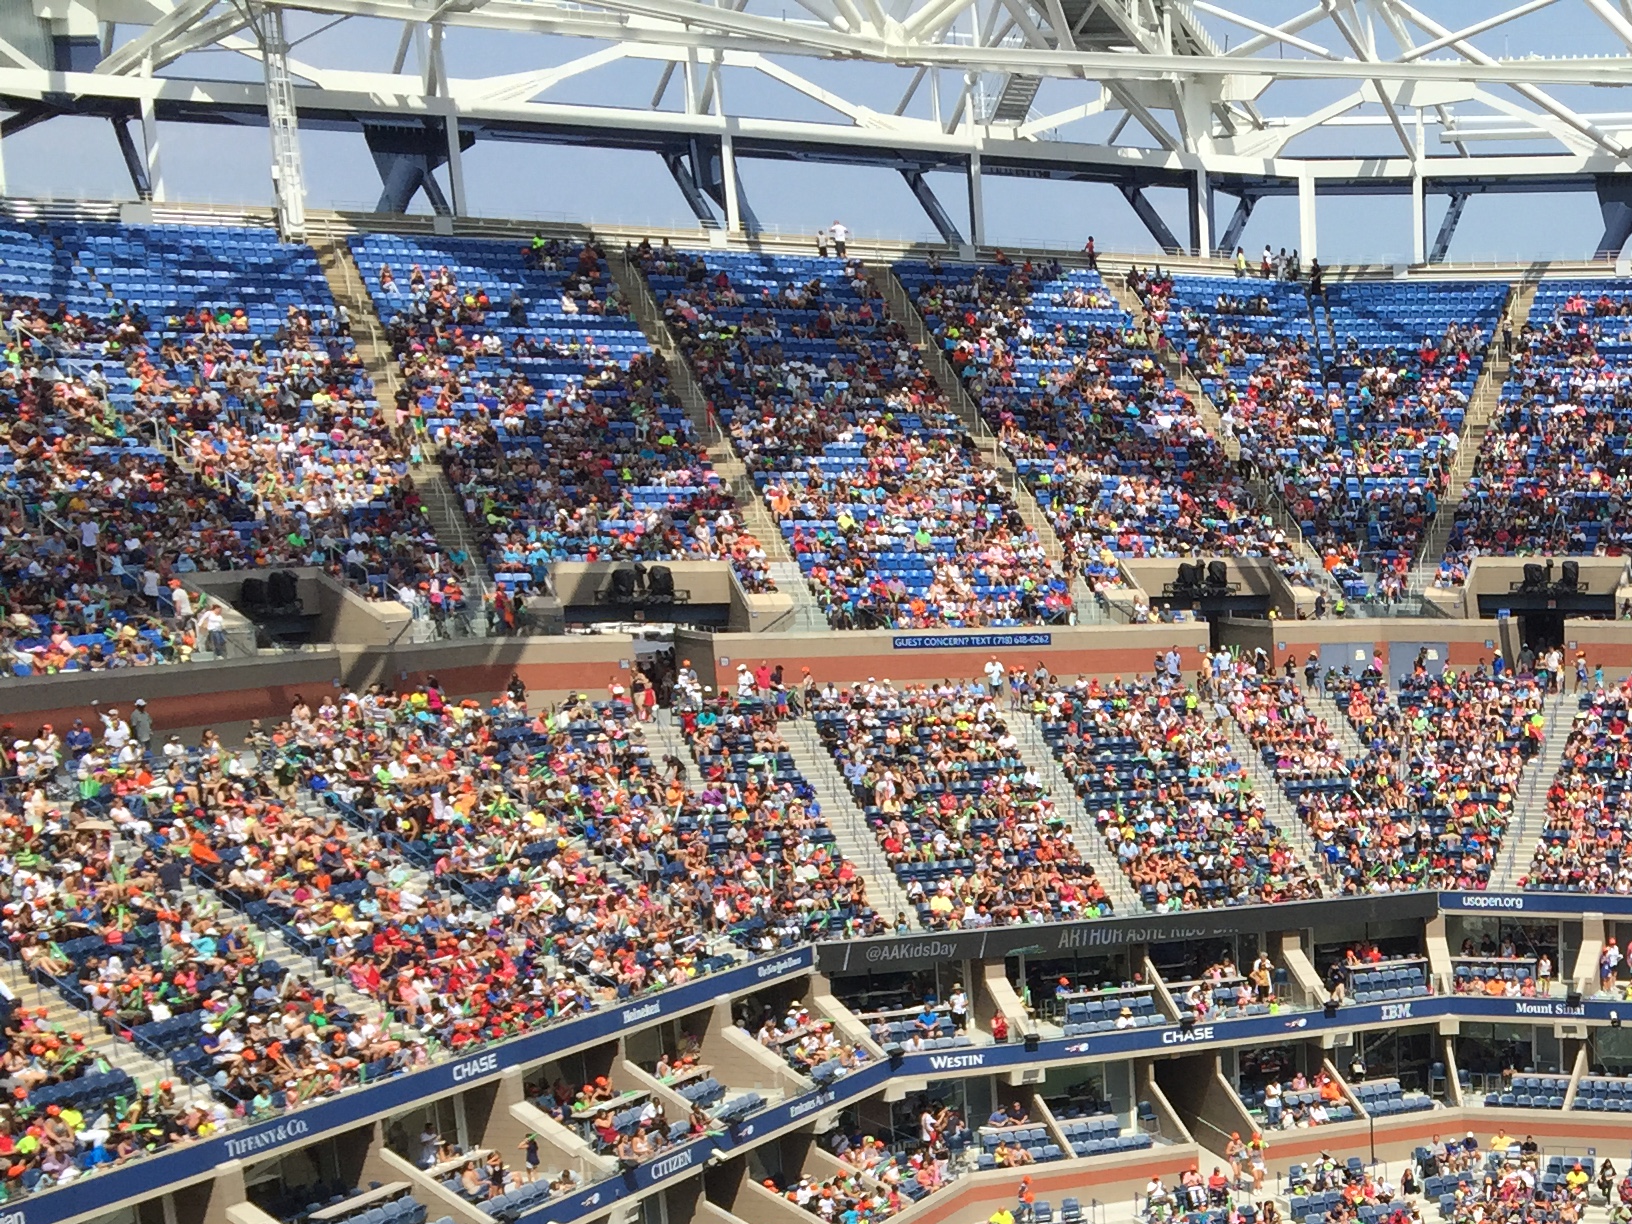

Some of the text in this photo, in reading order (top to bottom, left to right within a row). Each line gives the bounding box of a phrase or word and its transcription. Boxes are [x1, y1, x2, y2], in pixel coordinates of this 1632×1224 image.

[895, 638, 922, 647] GUEST
[923, 637, 969, 647] CONCERN?
[971, 636, 991, 645] TEXT
[1463, 895, 1524, 909] usopen.org
[866, 941, 957, 962] @AAKidsDay
[1381, 1003, 1413, 1021] IBM
[1515, 1002, 1585, 1016] Mount Sinai
[1163, 1026, 1215, 1044] CHASE
[453, 1053, 498, 1081] CHASE
[929, 1053, 984, 1070] WESTIN
[651, 1149, 692, 1180] CITIZEN
